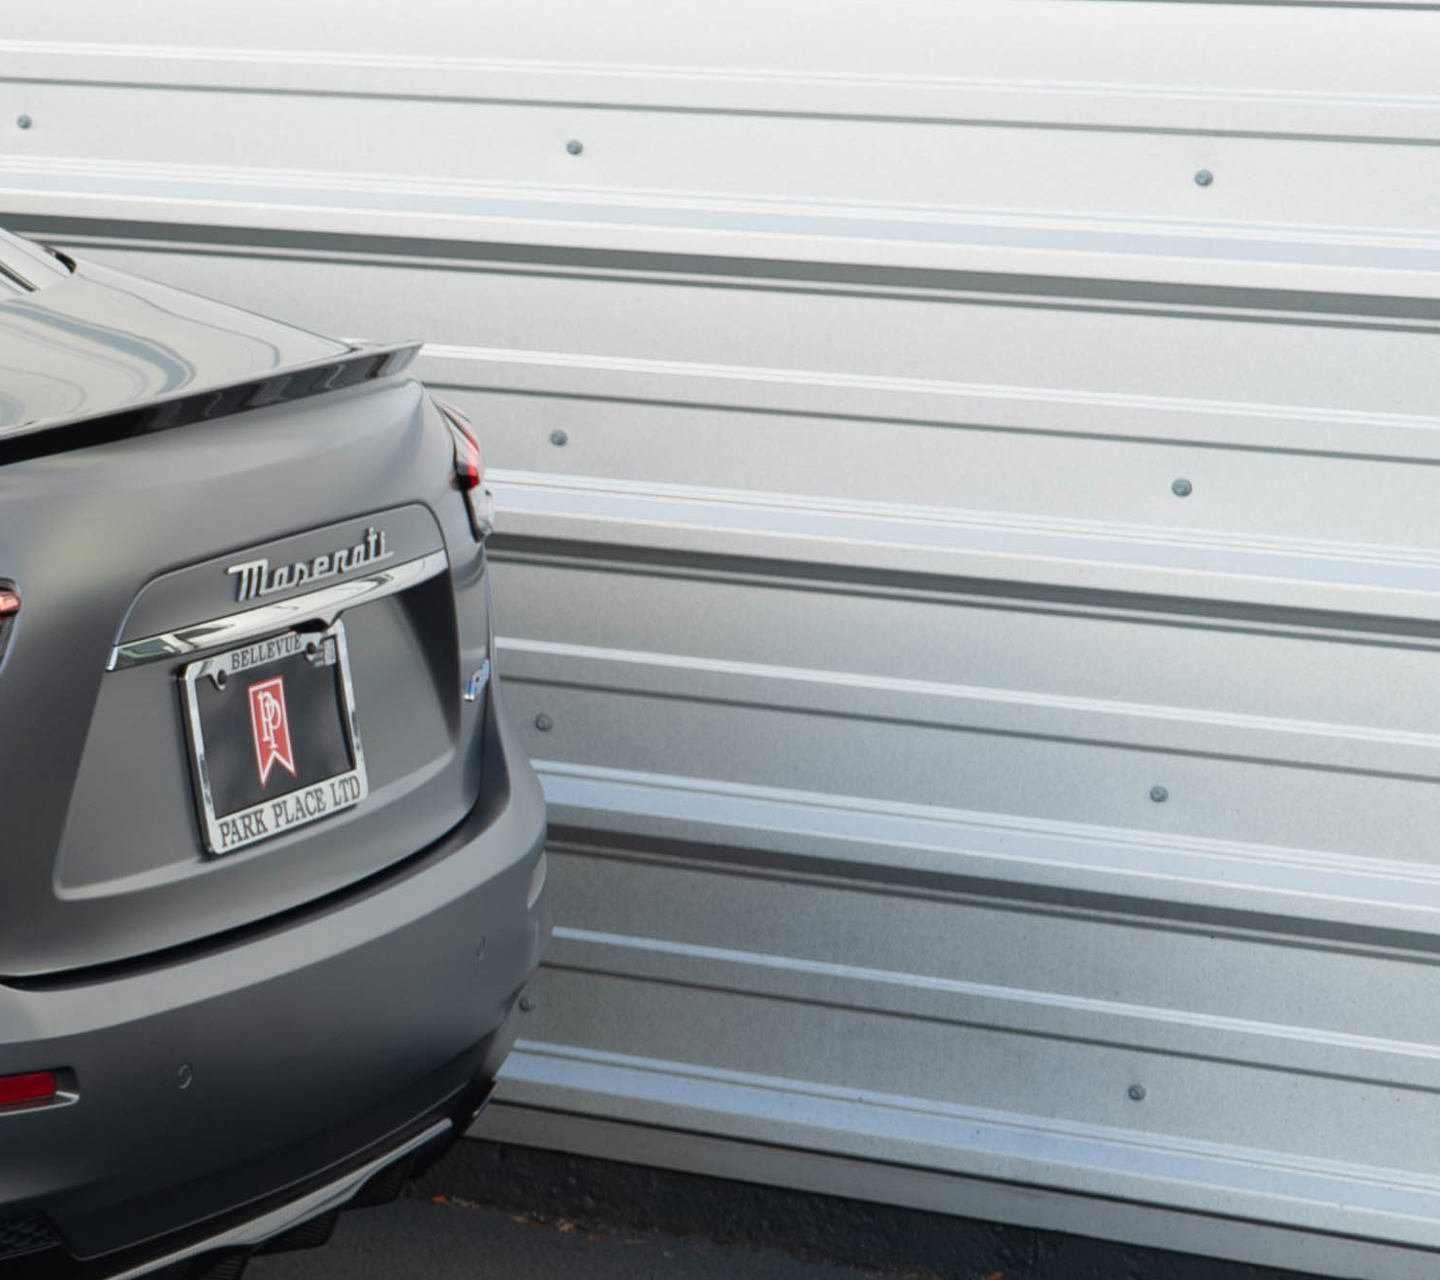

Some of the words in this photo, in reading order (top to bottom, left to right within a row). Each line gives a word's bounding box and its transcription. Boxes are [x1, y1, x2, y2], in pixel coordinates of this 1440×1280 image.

[227, 526, 395, 603] Maserati
[231, 632, 303, 671] BELLEVUE
[218, 809, 268, 848] PARK
[272, 786, 327, 829] PLACE
[329, 774, 361, 806] LTD
